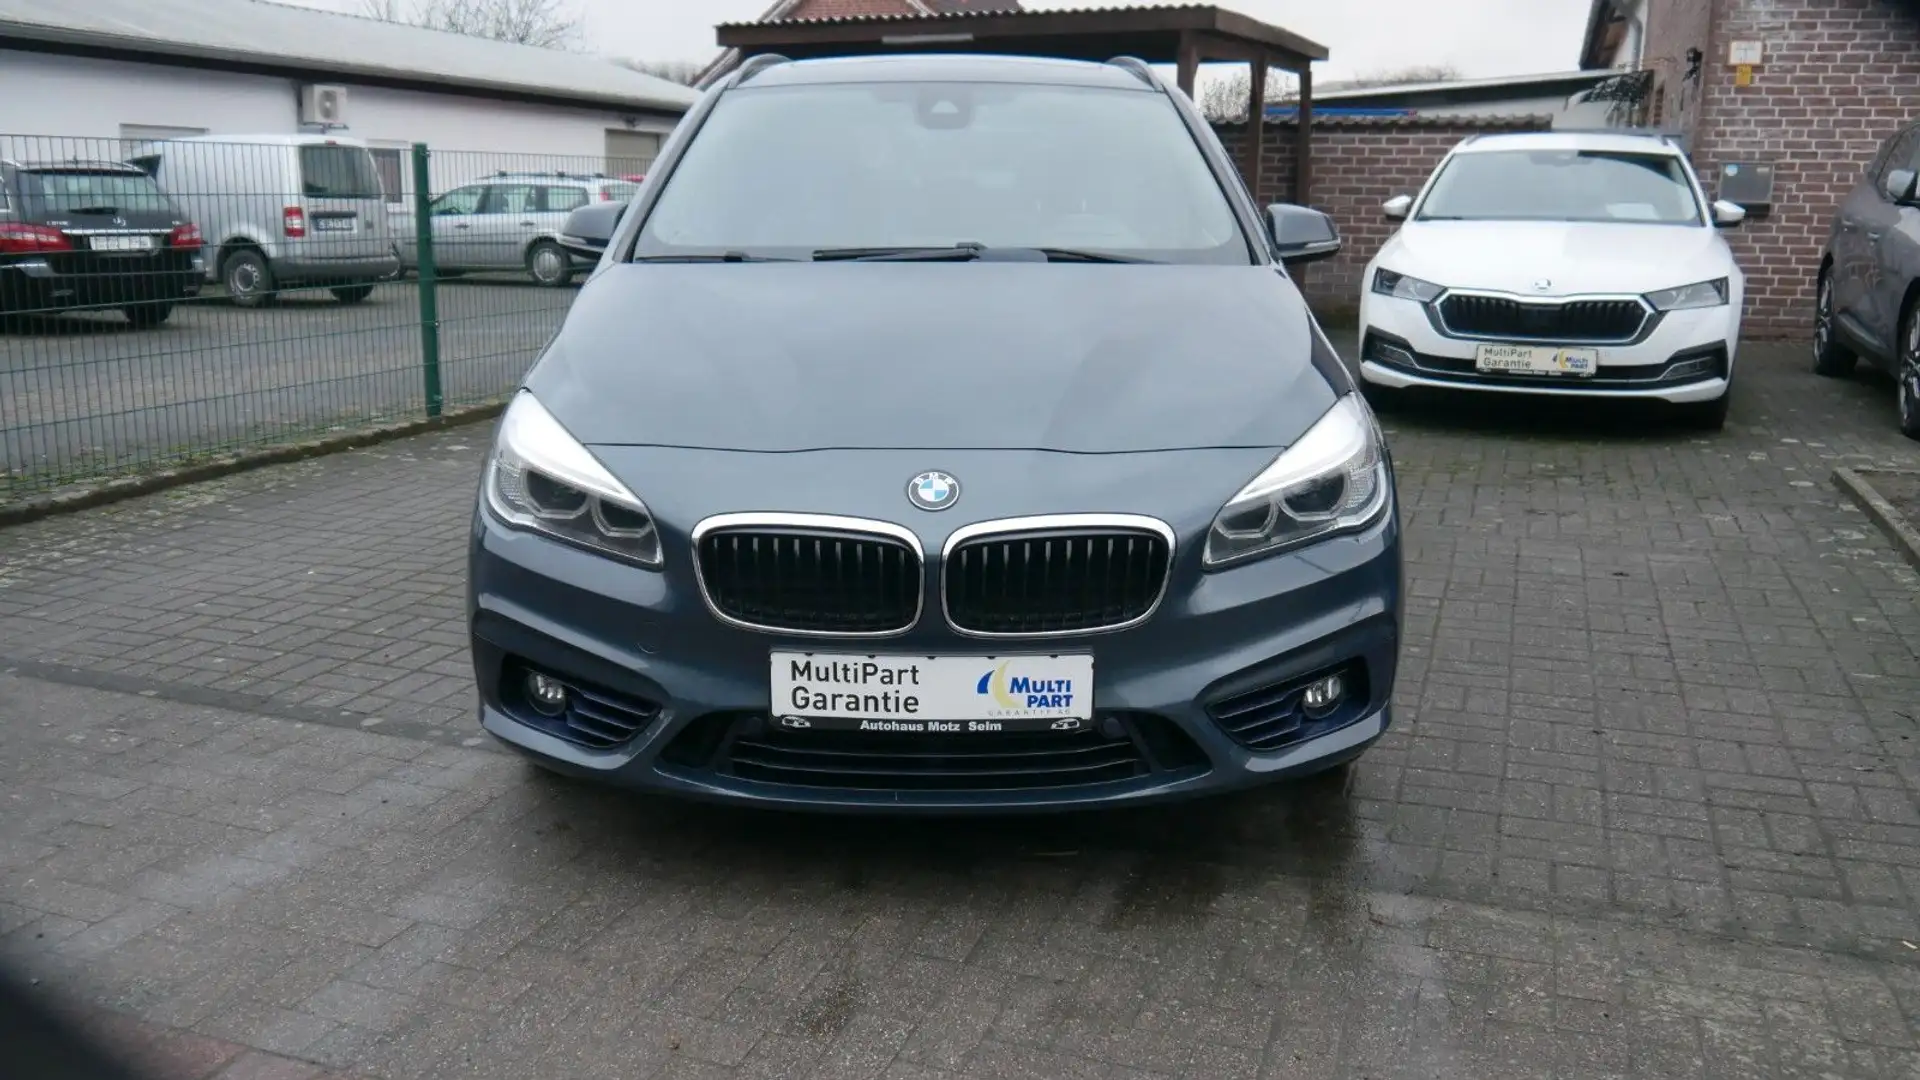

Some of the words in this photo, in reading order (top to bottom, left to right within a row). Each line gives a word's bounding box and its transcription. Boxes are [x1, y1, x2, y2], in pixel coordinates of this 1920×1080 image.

[1484, 347, 1532, 358] MultiPart
[1484, 357, 1532, 369] Garantie
[790, 660, 919, 685] MultiPart
[1009, 677, 1071, 694] MULTI
[791, 686, 919, 713] Garantie
[1027, 694, 1073, 708] PART
[860, 720, 924, 731] Autohaus
[928, 721, 961, 732] Motz
[968, 721, 1002, 732] Selm
